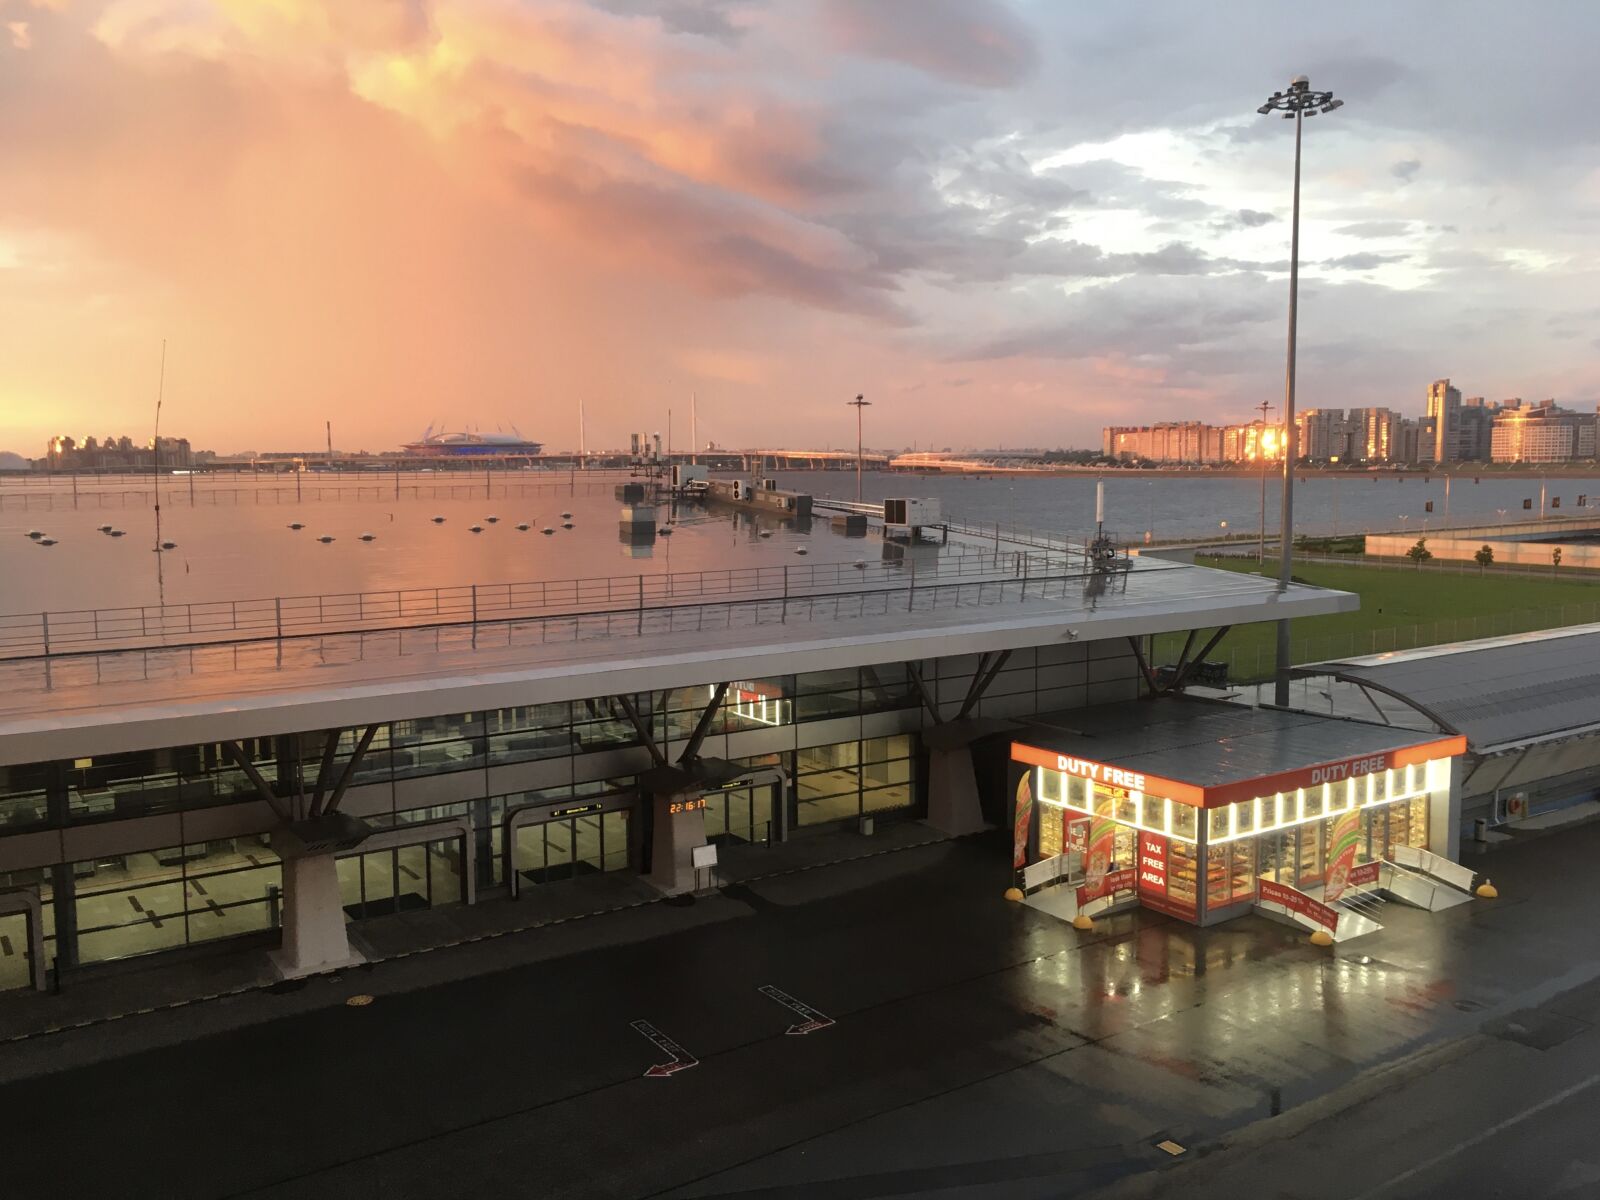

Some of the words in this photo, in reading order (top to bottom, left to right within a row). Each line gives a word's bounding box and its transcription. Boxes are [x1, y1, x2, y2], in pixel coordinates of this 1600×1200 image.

[1057, 755, 1099, 778] DUTY
[1103, 767, 1145, 790] FREE
[1311, 764, 1349, 784] DUTY
[1352, 756, 1385, 775] FREE
[670, 799, 706, 814] 22:16:17
[1146, 842, 1161, 855] TAX
[1142, 857, 1164, 870] FREE
[1142, 872, 1164, 886] AREA
